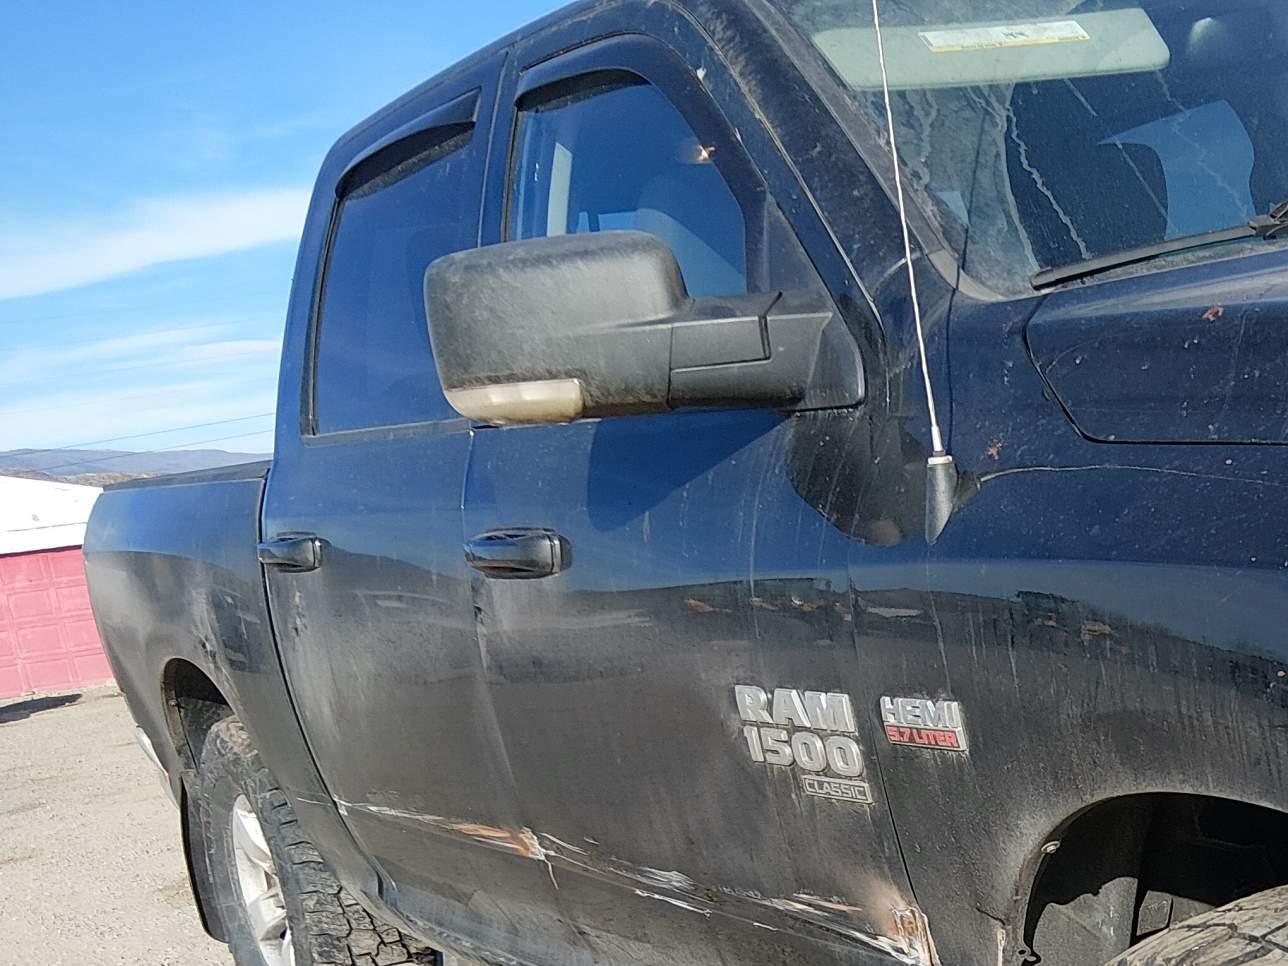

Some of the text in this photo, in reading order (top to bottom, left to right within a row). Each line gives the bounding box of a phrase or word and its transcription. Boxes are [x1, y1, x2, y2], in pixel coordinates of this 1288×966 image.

[734, 685, 859, 733] RAM
[880, 696, 962, 729] HEMI
[744, 725, 864, 777] 1500
[888, 726, 959, 748] 5.7 LITER
[806, 778, 867, 801] CLASSIC
